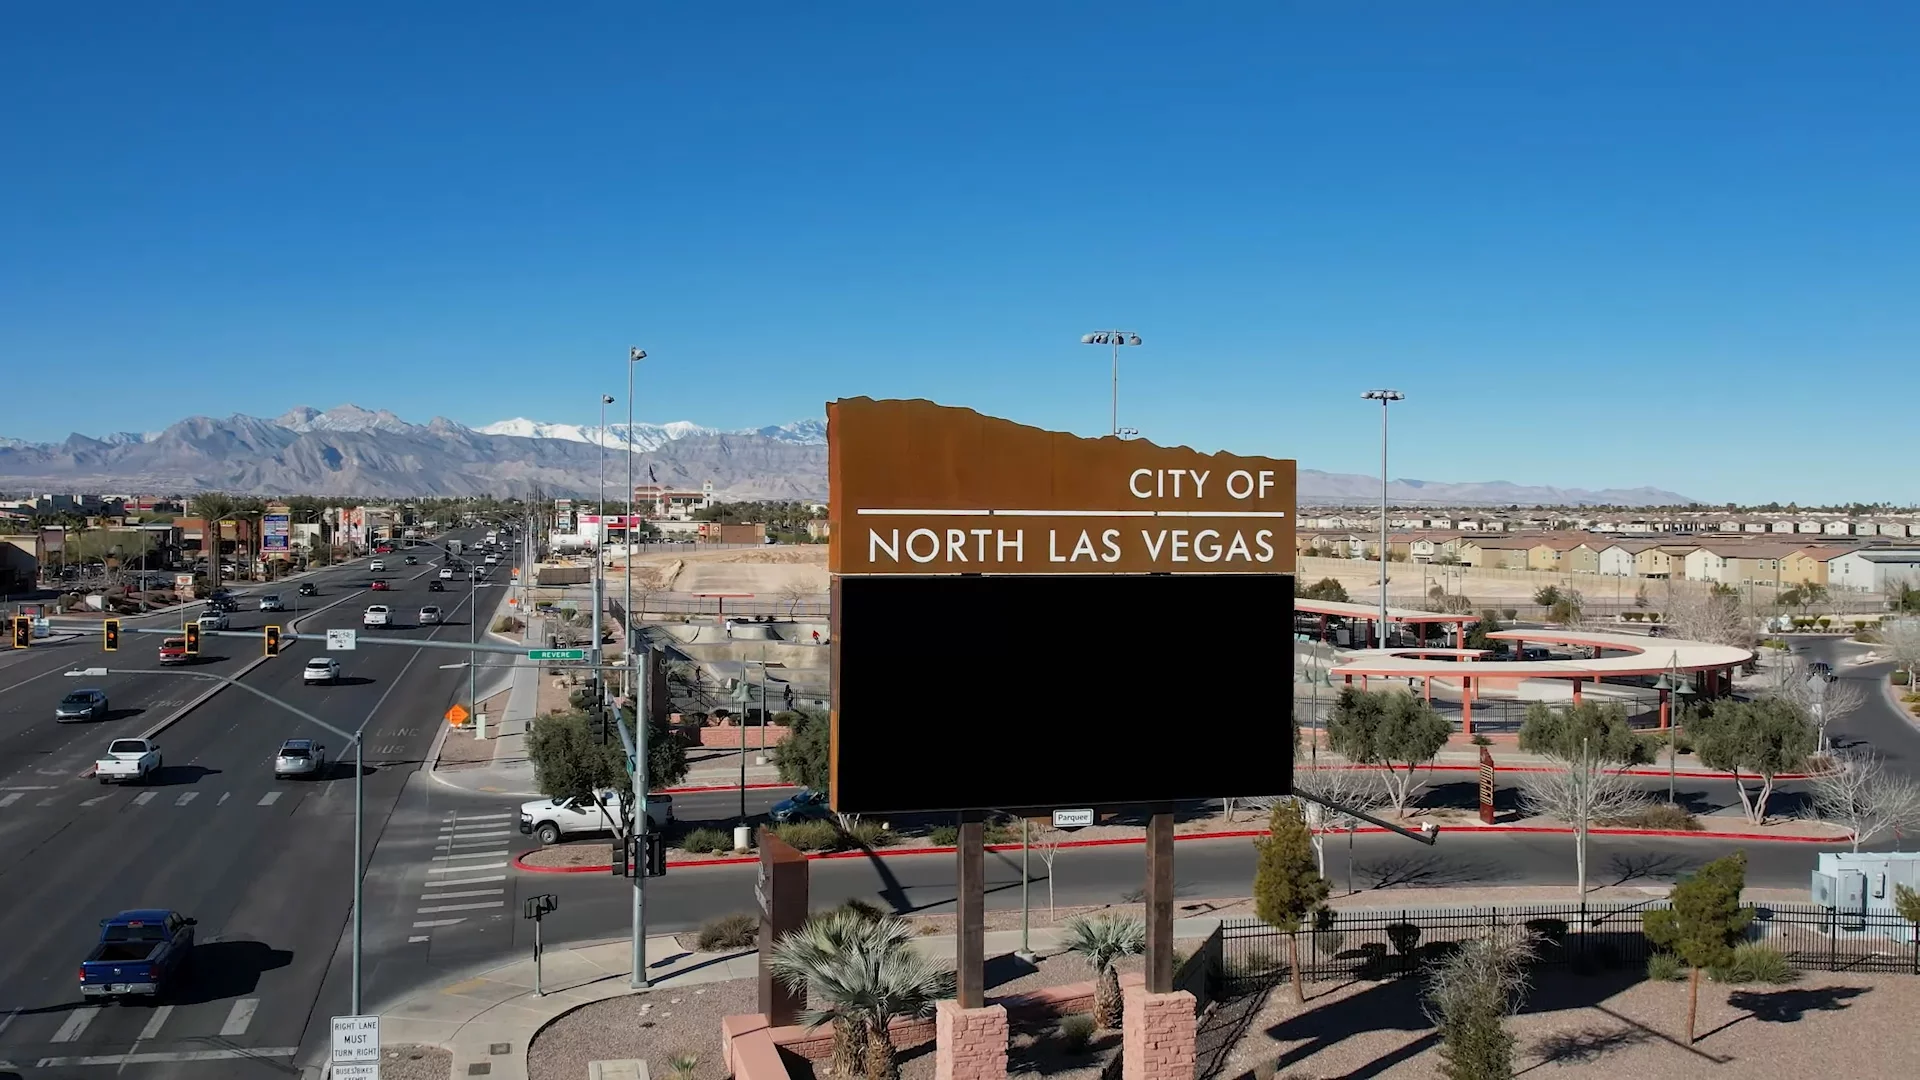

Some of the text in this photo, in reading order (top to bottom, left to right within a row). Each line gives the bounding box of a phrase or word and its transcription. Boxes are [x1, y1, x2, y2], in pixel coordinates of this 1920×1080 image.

[1129, 468, 1275, 500] CITY OF
[869, 528, 1275, 563] NORTH LAS VEGAS
[1058, 813, 1089, 822] Parquee
[335, 1022, 377, 1030] RIGHT LANE
[344, 1034, 367, 1044] MUST
[335, 1048, 377, 1057] TURN RIGHT
